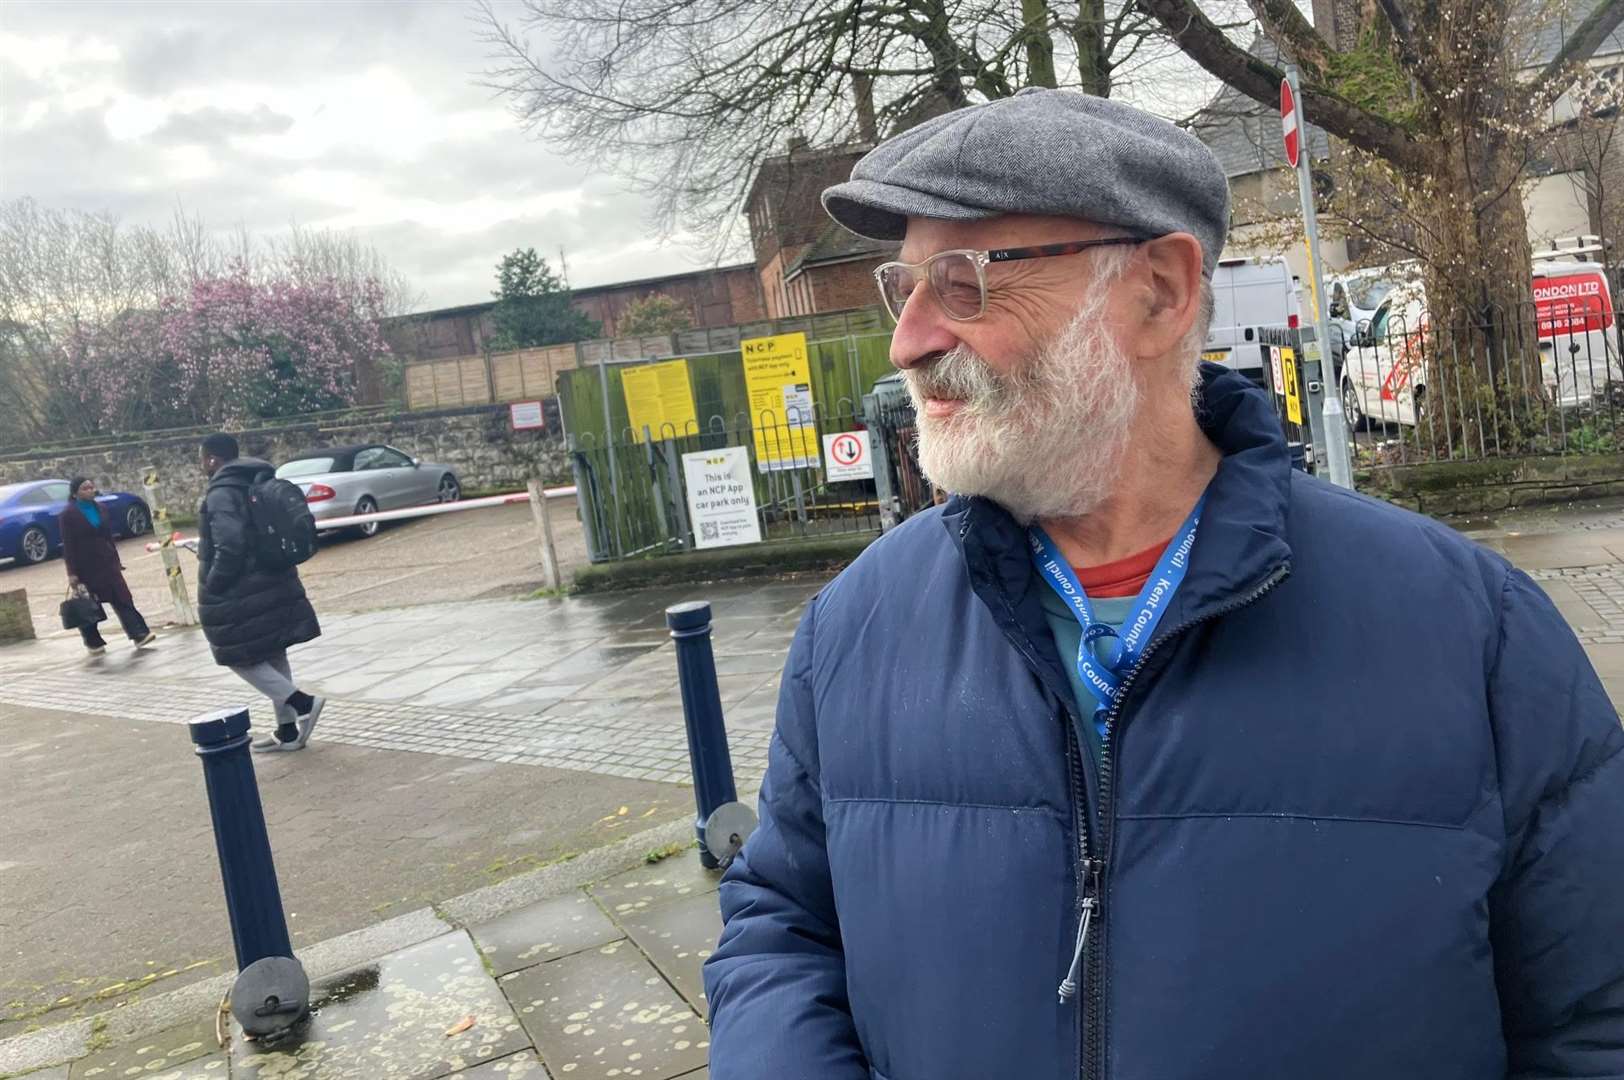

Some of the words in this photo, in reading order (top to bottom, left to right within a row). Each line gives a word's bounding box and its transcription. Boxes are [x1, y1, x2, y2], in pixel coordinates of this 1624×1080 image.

[1533, 284, 1577, 297] ONDON
[1578, 281, 1599, 295] LTD
[746, 342, 774, 354] NCP
[704, 472, 722, 482] This
[723, 472, 731, 480] is
[709, 485, 726, 495] NCP
[727, 484, 743, 495] App
[711, 498, 730, 510] park
[730, 496, 750, 506] only
[1044, 560, 1075, 595] Council
[1146, 578, 1172, 609] Kent
